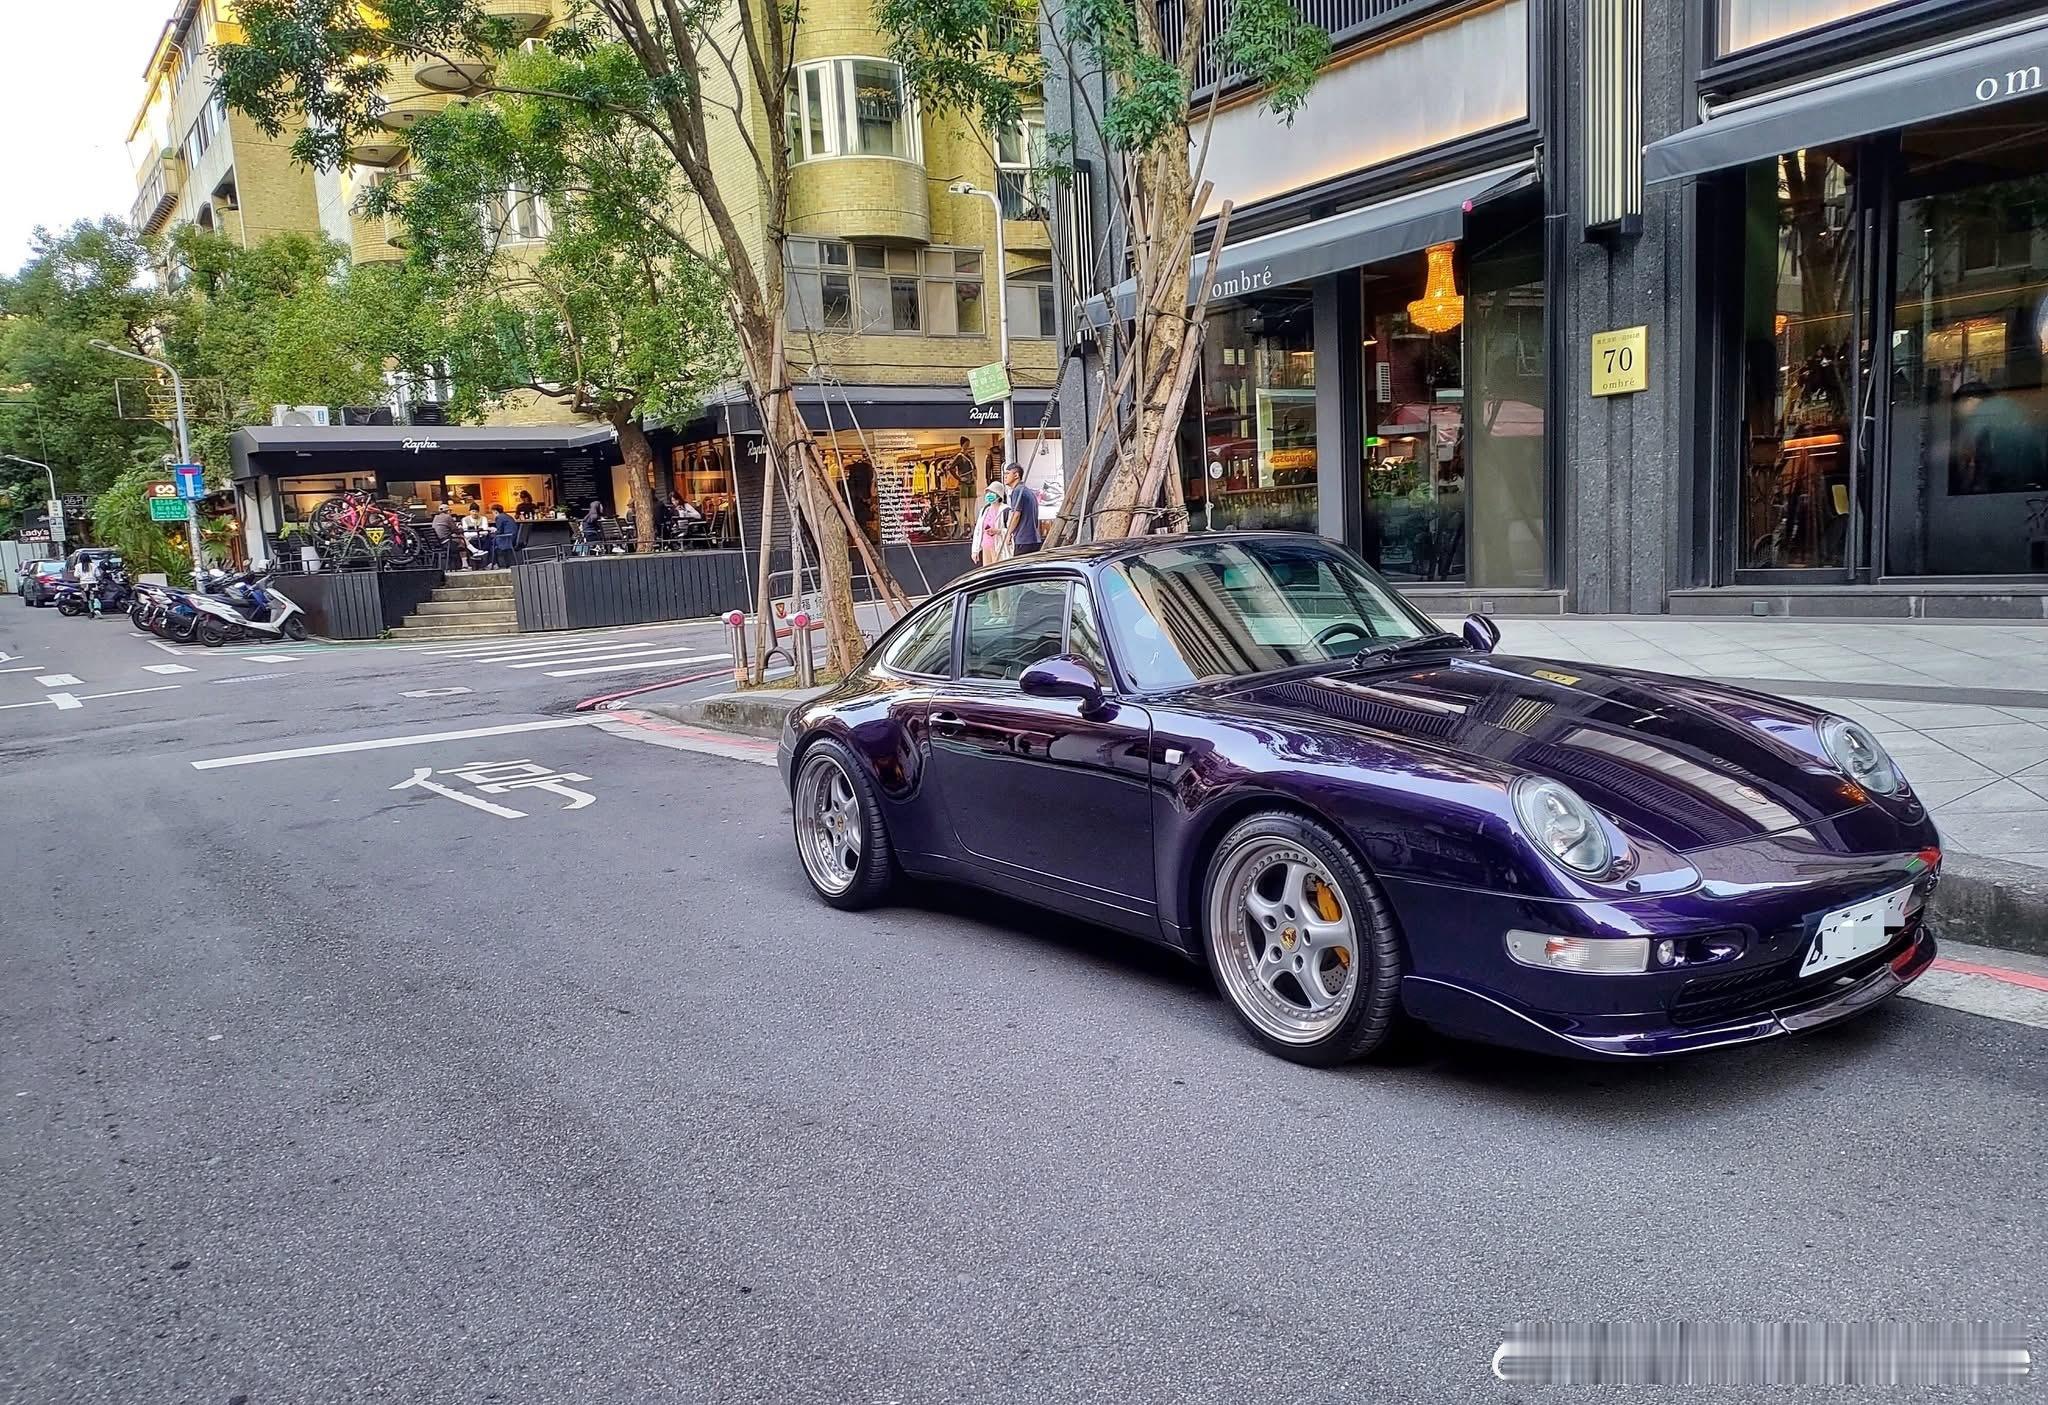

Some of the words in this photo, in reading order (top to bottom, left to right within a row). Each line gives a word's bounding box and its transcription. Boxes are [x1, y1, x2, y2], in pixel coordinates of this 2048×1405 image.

[1212, 265, 1272, 298] ombré
[1602, 347, 1633, 374] 70
[969, 406, 999, 425] Rapha
[402, 436, 437, 454] Rapha
[747, 436, 768, 464] Raph
[20, 528, 50, 537] Lady's
[389, 758, 597, 819] 停
